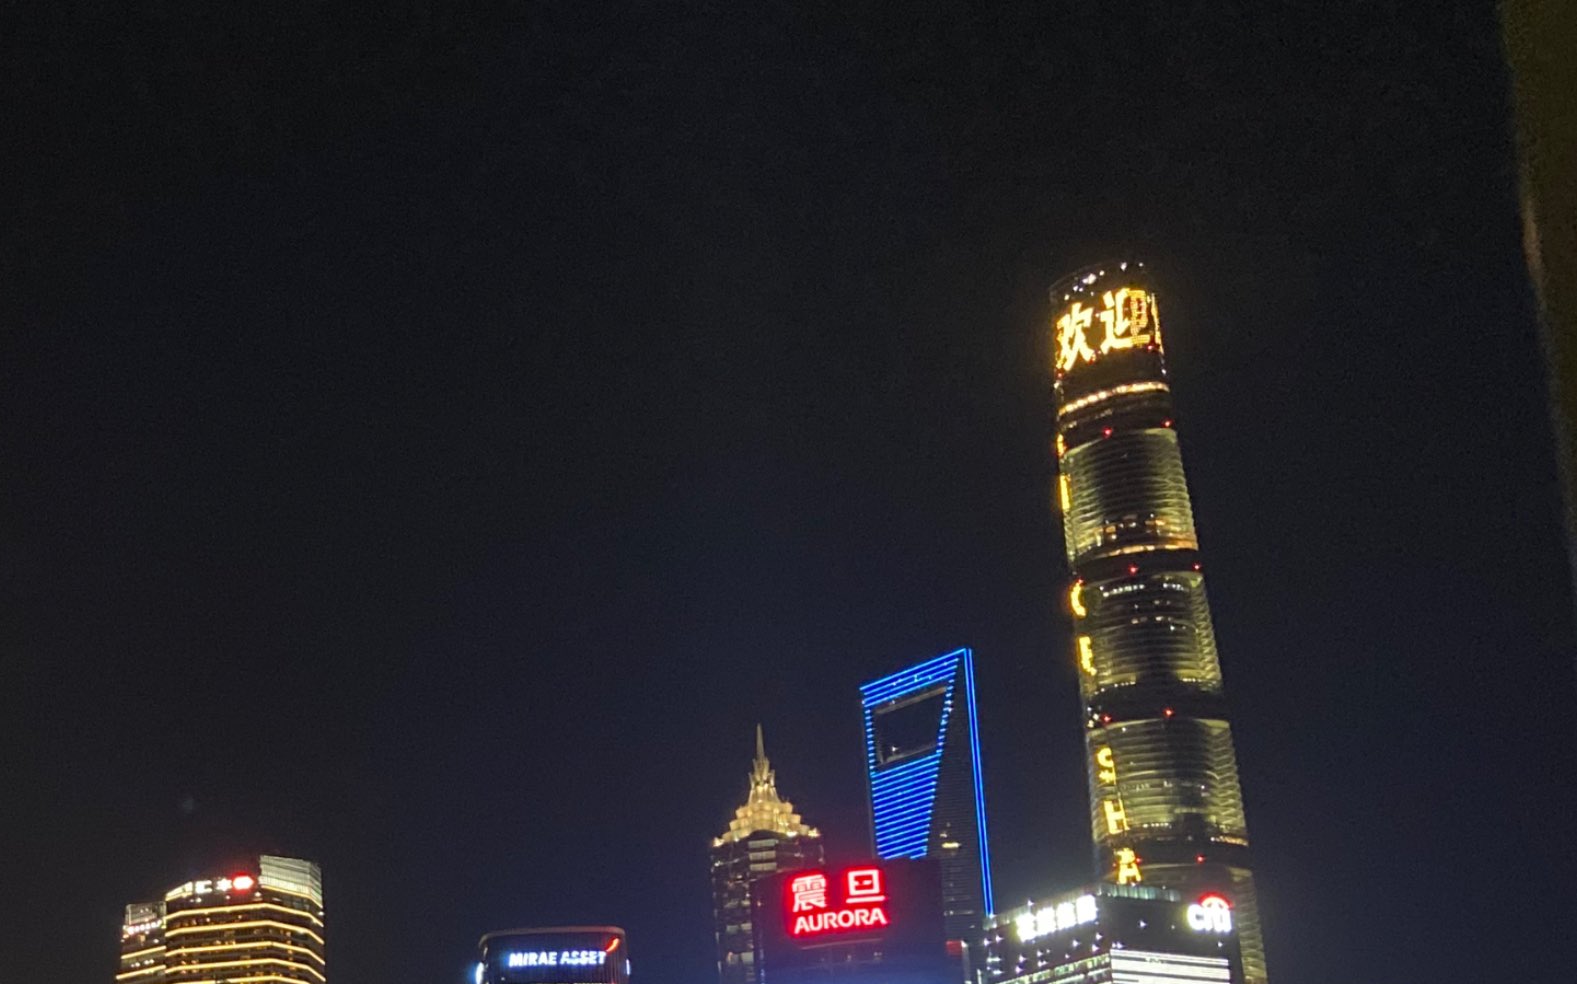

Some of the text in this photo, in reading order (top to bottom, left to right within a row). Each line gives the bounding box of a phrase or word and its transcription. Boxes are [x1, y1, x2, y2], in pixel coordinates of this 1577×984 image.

[1056, 288, 1150, 371] 欢迎
[792, 868, 886, 912] 震旦
[794, 908, 888, 935] AURORA
[508, 950, 607, 967] MIRAE ASSET
